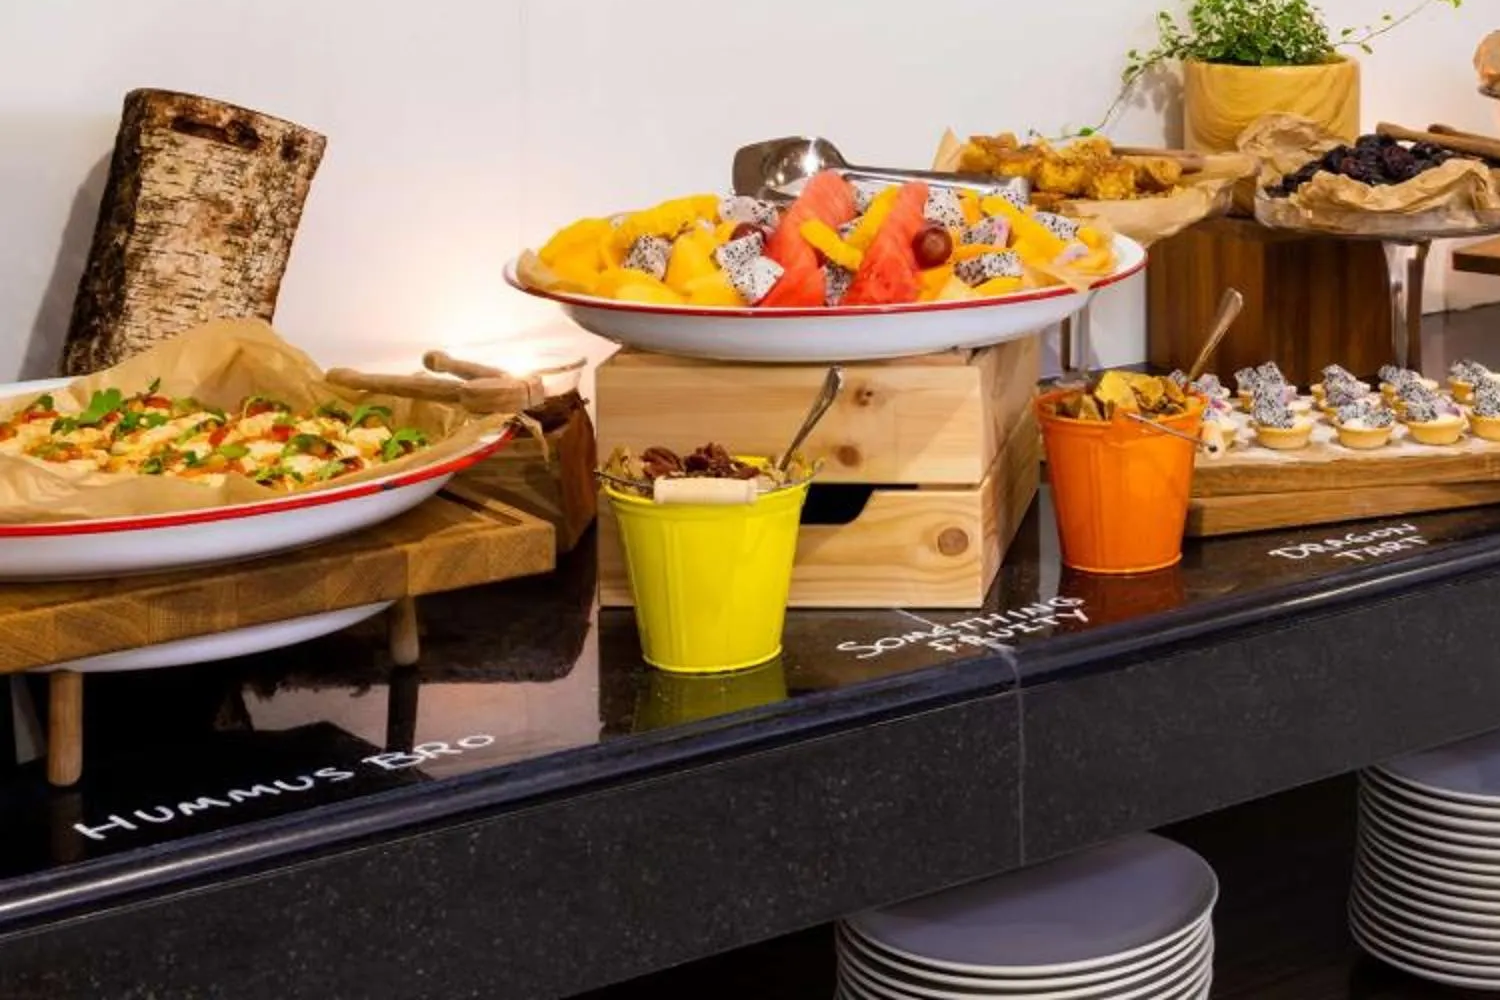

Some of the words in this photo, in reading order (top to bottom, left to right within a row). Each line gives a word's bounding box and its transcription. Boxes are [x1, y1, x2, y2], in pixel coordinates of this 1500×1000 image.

[1268, 523, 1417, 559] DRAGON
[1331, 535, 1429, 560] TART
[74, 766, 355, 841] HUMMUS
[361, 733, 496, 771] BRO
